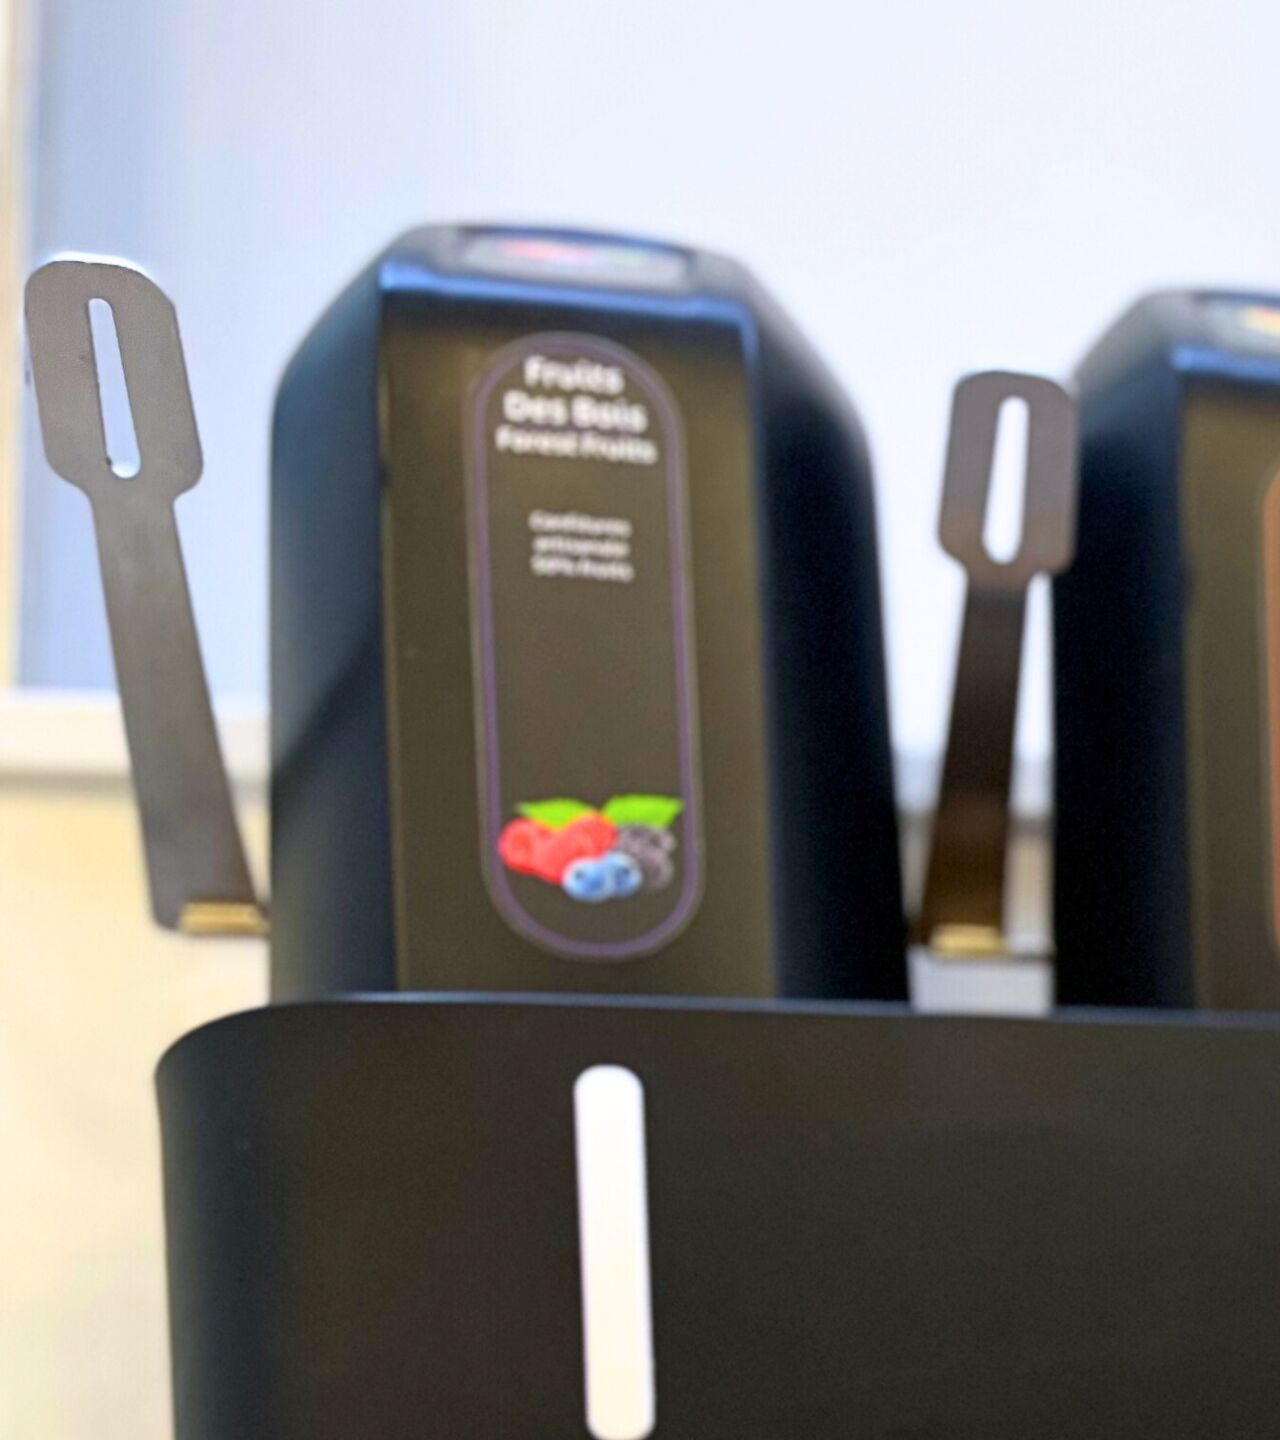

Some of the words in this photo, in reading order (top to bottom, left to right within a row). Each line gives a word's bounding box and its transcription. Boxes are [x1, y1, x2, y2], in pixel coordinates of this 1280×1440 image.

[524, 354, 625, 396] Fruits
[502, 389, 567, 427] Des
[571, 394, 648, 434] Bois
[495, 424, 578, 457] Forest
